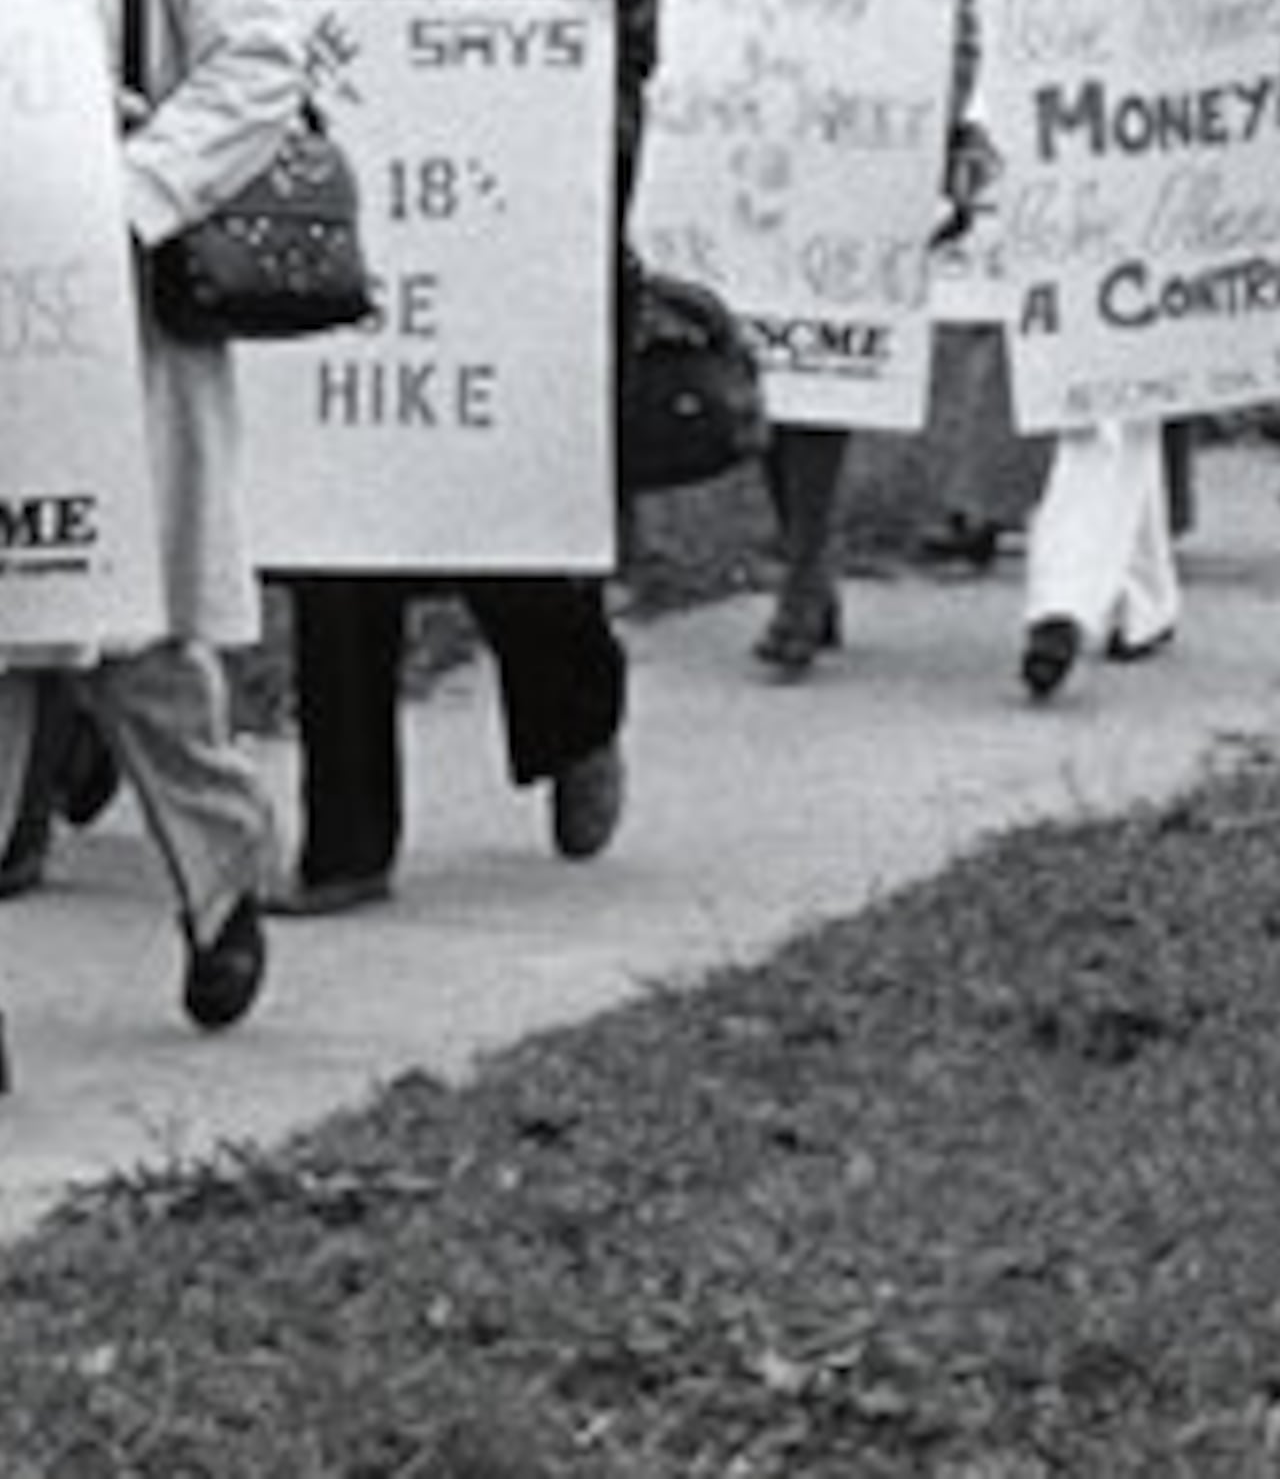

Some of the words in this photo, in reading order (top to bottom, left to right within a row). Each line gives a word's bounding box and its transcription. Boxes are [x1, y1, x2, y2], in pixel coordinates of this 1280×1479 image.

[408, 17, 587, 68] SAYS
[1021, 280, 1060, 337] A
[319, 360, 496, 429] HIKE
